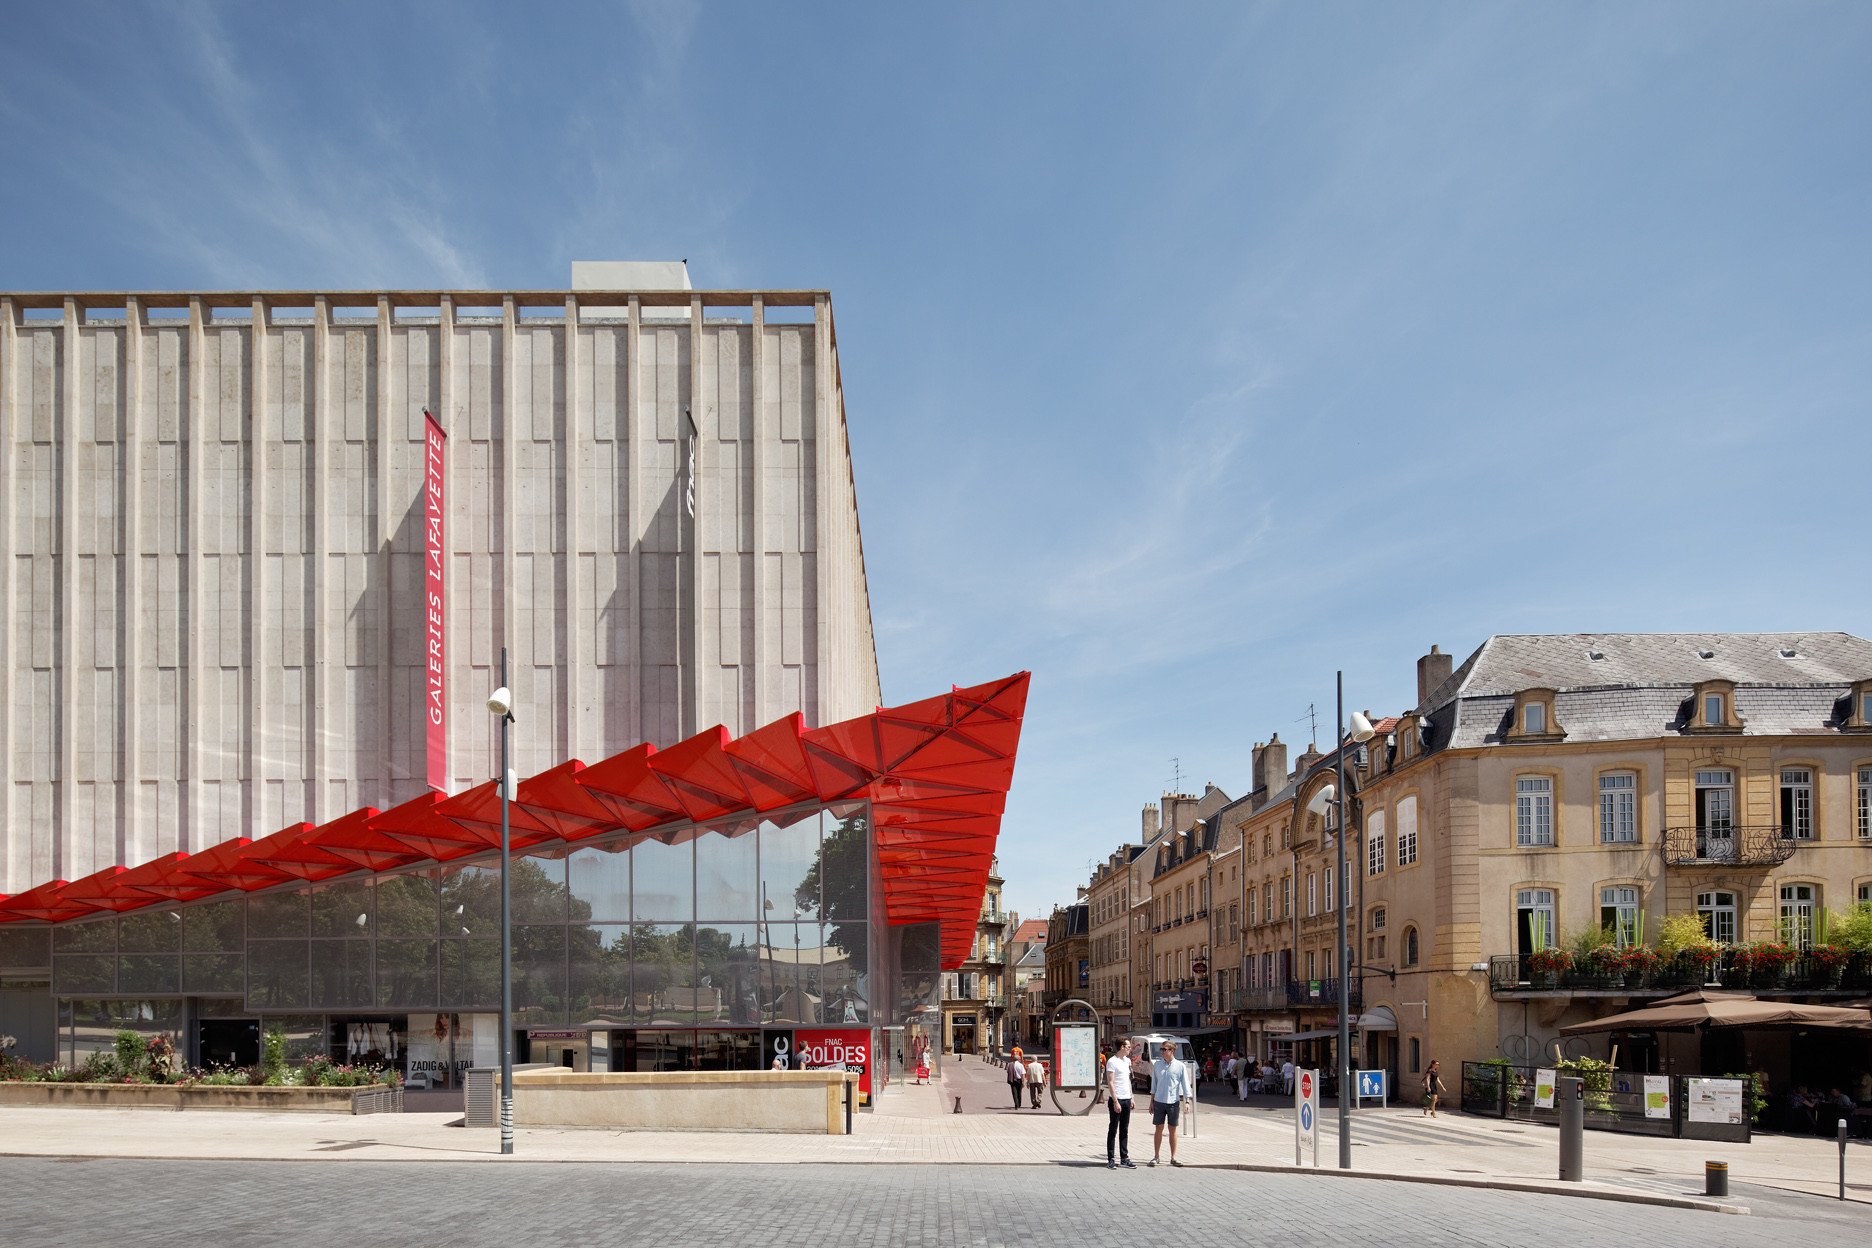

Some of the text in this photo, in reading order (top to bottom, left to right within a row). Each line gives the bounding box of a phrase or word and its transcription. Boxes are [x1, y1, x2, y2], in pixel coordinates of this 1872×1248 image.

[429, 430, 442, 725] GALERIES LAFAYETTE
[824, 1038, 843, 1046] FNAC
[774, 1036, 789, 1070] ac
[805, 1046, 866, 1064] SOLDES
[1302, 1081, 1312, 1090] STOP
